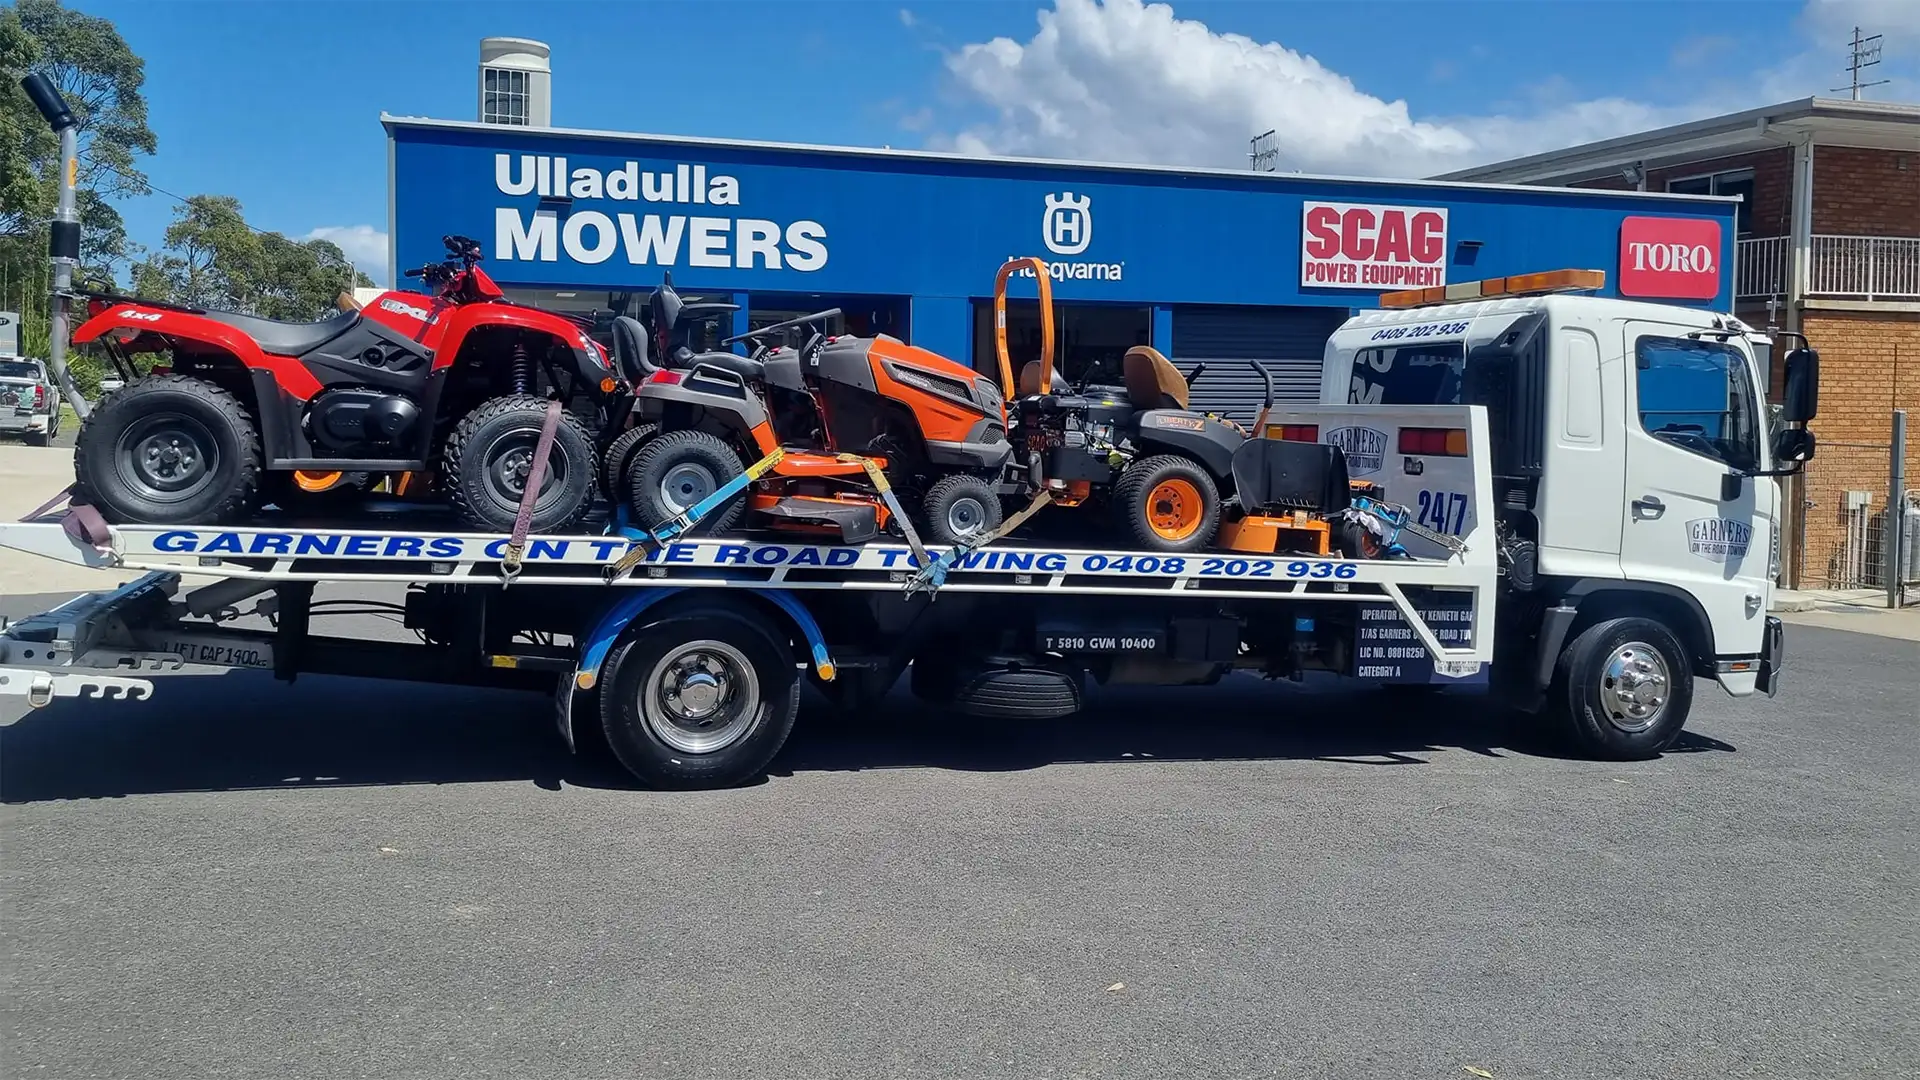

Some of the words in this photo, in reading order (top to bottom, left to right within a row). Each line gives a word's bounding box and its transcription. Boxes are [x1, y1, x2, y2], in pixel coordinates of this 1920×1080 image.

[495, 153, 740, 205] Ulladulla
[495, 207, 829, 272] MOWERS
[1306, 206, 1444, 264] SCAG
[1628, 242, 1713, 273] TORO
[1305, 262, 1357, 284] POWER
[1361, 264, 1443, 286] EQUIPMENT
[1371, 327, 1408, 341] 0408
[1406, 324, 1438, 338] 202
[1436, 322, 1469, 336] 936
[1331, 428, 1381, 453] GARNERS
[1418, 490, 1468, 535] 24/7
[1692, 519, 1749, 543] GARNERS
[152, 531, 465, 558] GARNERS
[484, 538, 571, 560] ON
[714, 545, 861, 568] ROAD
[878, 548, 1067, 572] TOWING
[1082, 555, 1186, 574] 0408
[1199, 559, 1276, 577] 202
[1286, 561, 1359, 580] 936
[1692, 542, 1700, 553] ON
[1701, 543, 1712, 554] THE
[1712, 544, 1727, 555] ROAD
[1727, 545, 1747, 556] TOWING
[1362, 609, 1398, 621] OPERATOR
[1428, 610, 1459, 621] KENNETH
[1046, 637, 1054, 649] T
[1058, 638, 1085, 649] 5810
[1089, 638, 1116, 649] GVM
[1120, 638, 1156, 650] 10400
[1361, 628, 1378, 640] T/AS
[1379, 629, 1411, 640] GARNERS
[1440, 629, 1458, 640] ROAD
[200, 646, 223, 661] CAP
[1360, 647, 1371, 658] LIC
[1373, 647, 1386, 658] NO.
[1387, 647, 1425, 659] 08016250
[1358, 665, 1393, 677] CATEGORY
[1395, 666, 1401, 677] A
